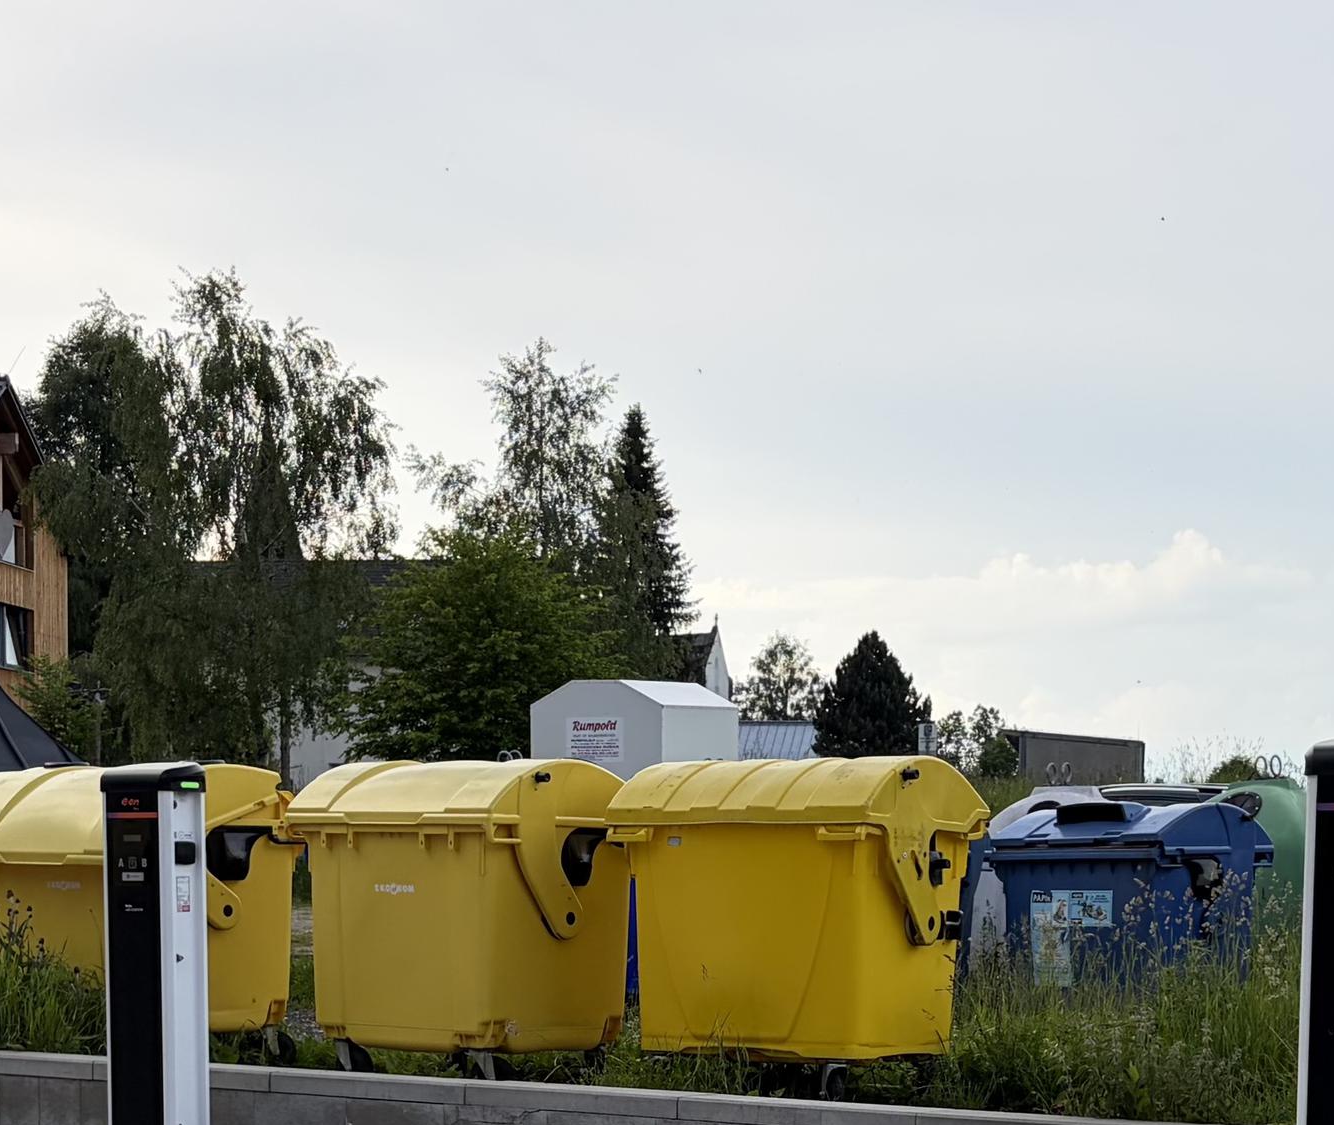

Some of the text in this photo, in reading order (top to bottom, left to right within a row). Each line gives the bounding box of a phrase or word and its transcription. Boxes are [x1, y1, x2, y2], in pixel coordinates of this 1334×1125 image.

[572, 719, 618, 733] Rumpold
[118, 858, 148, 868] A B
